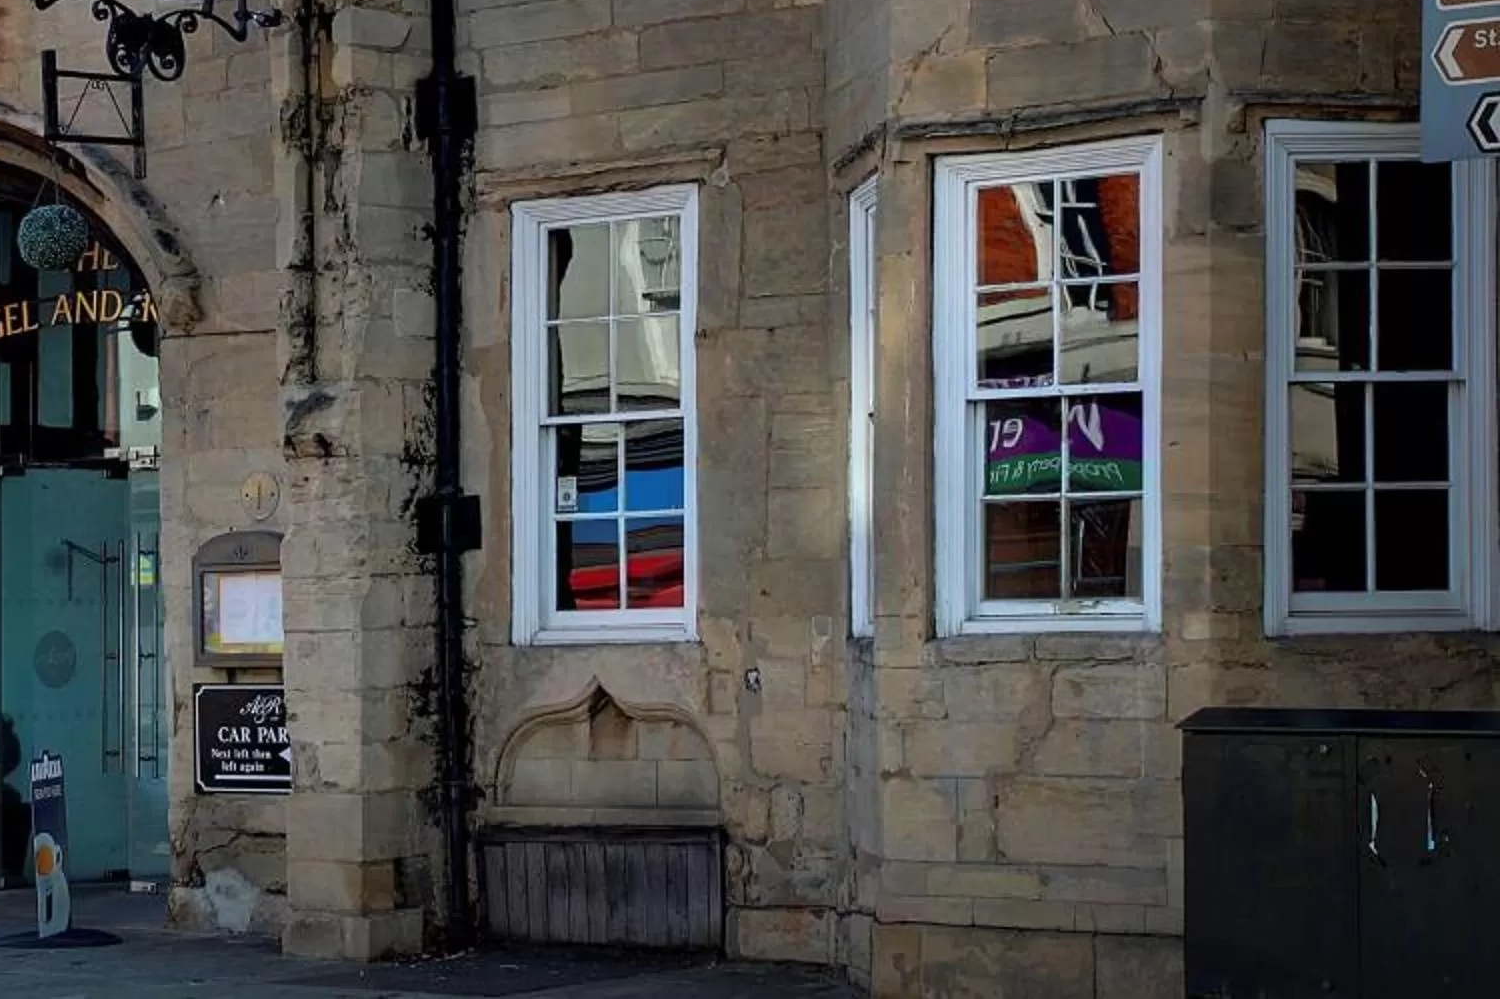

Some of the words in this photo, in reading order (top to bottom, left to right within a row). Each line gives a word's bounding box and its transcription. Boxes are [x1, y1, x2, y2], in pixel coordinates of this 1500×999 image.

[51, 290, 123, 327] AND
[217, 726, 251, 743] CAR
[257, 726, 290, 743] PAR
[211, 748, 231, 758] Next
[233, 748, 249, 759] left
[251, 748, 272, 759] then
[221, 761, 237, 772] left
[240, 761, 265, 773] again
